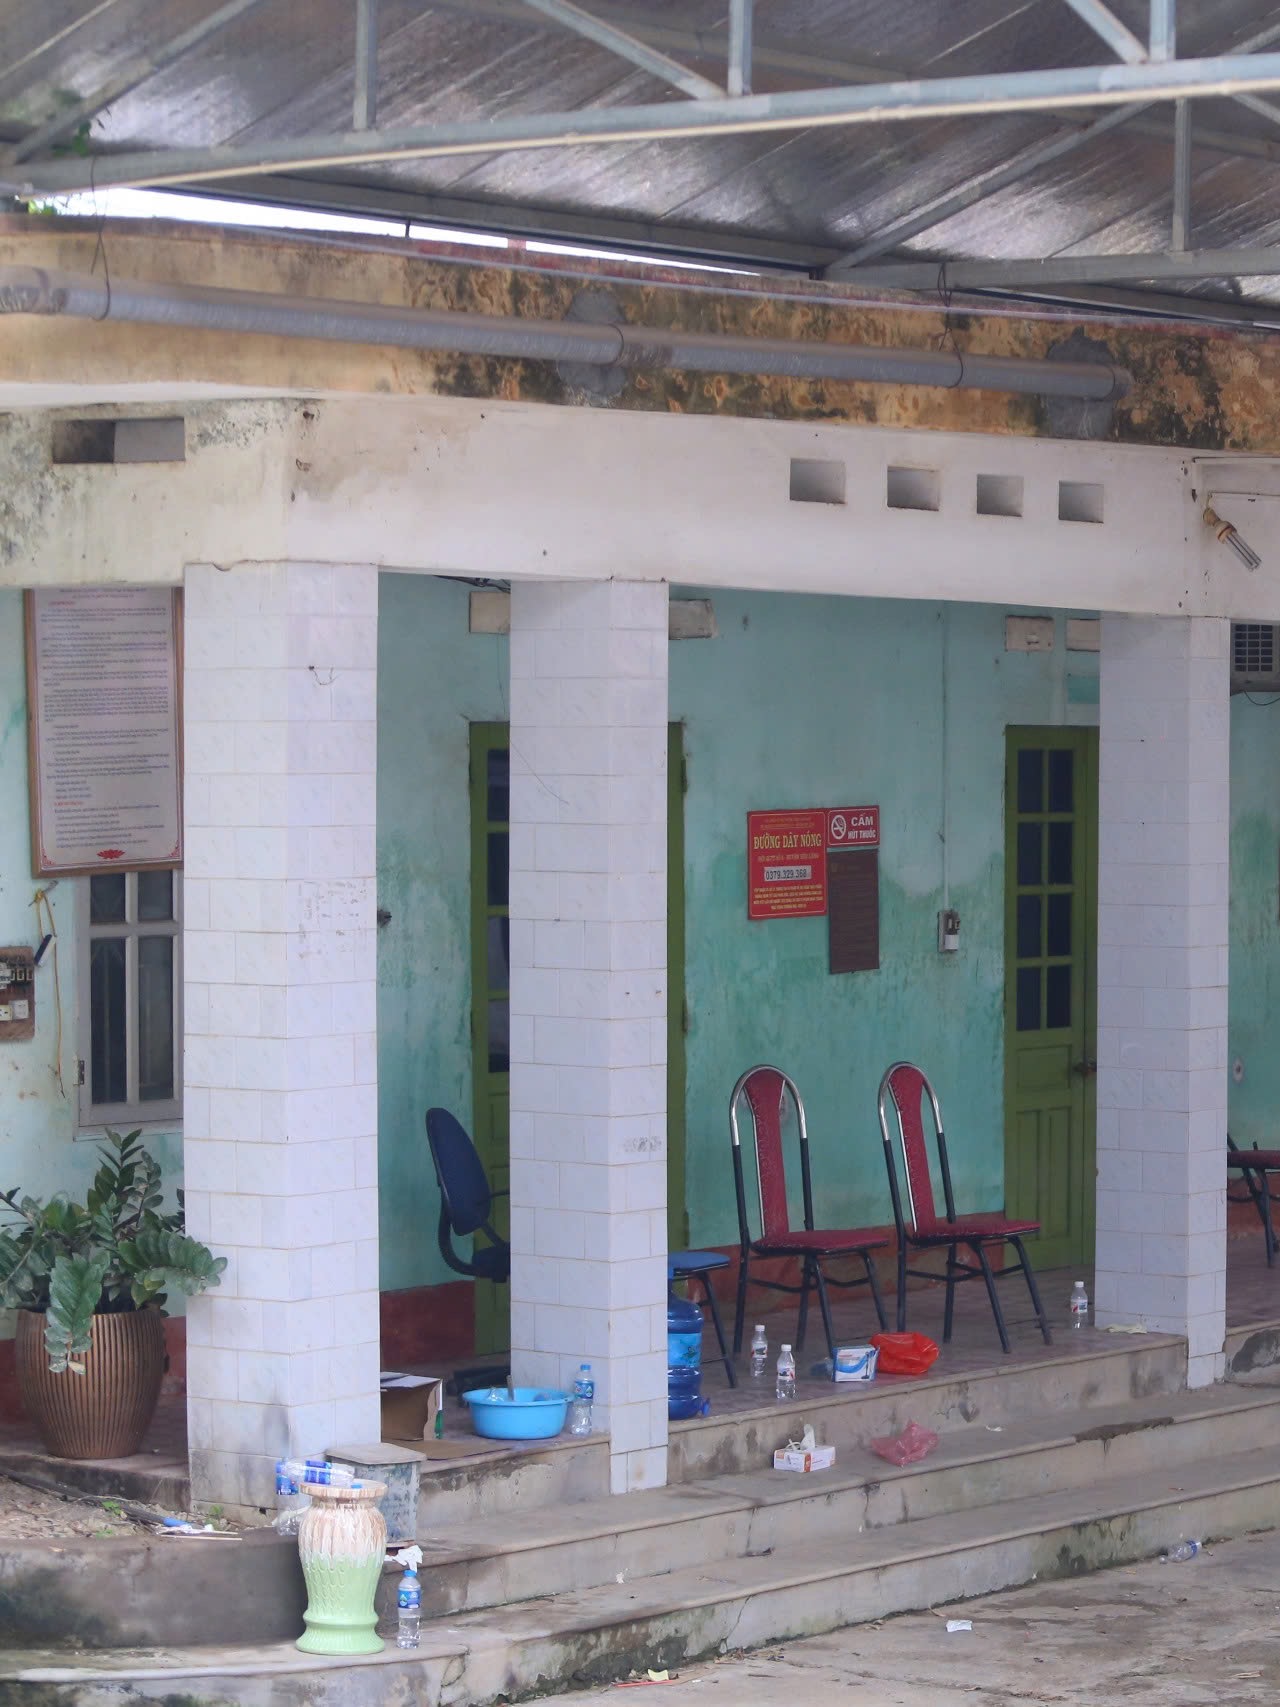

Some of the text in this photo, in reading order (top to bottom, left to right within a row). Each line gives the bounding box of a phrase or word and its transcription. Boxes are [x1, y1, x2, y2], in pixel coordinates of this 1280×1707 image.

[851, 813, 874, 827] CẤM
[754, 830, 822, 850] ĐƯỜNG DÂY NÓNG
[848, 827, 876, 840] HÚT THUỐC
